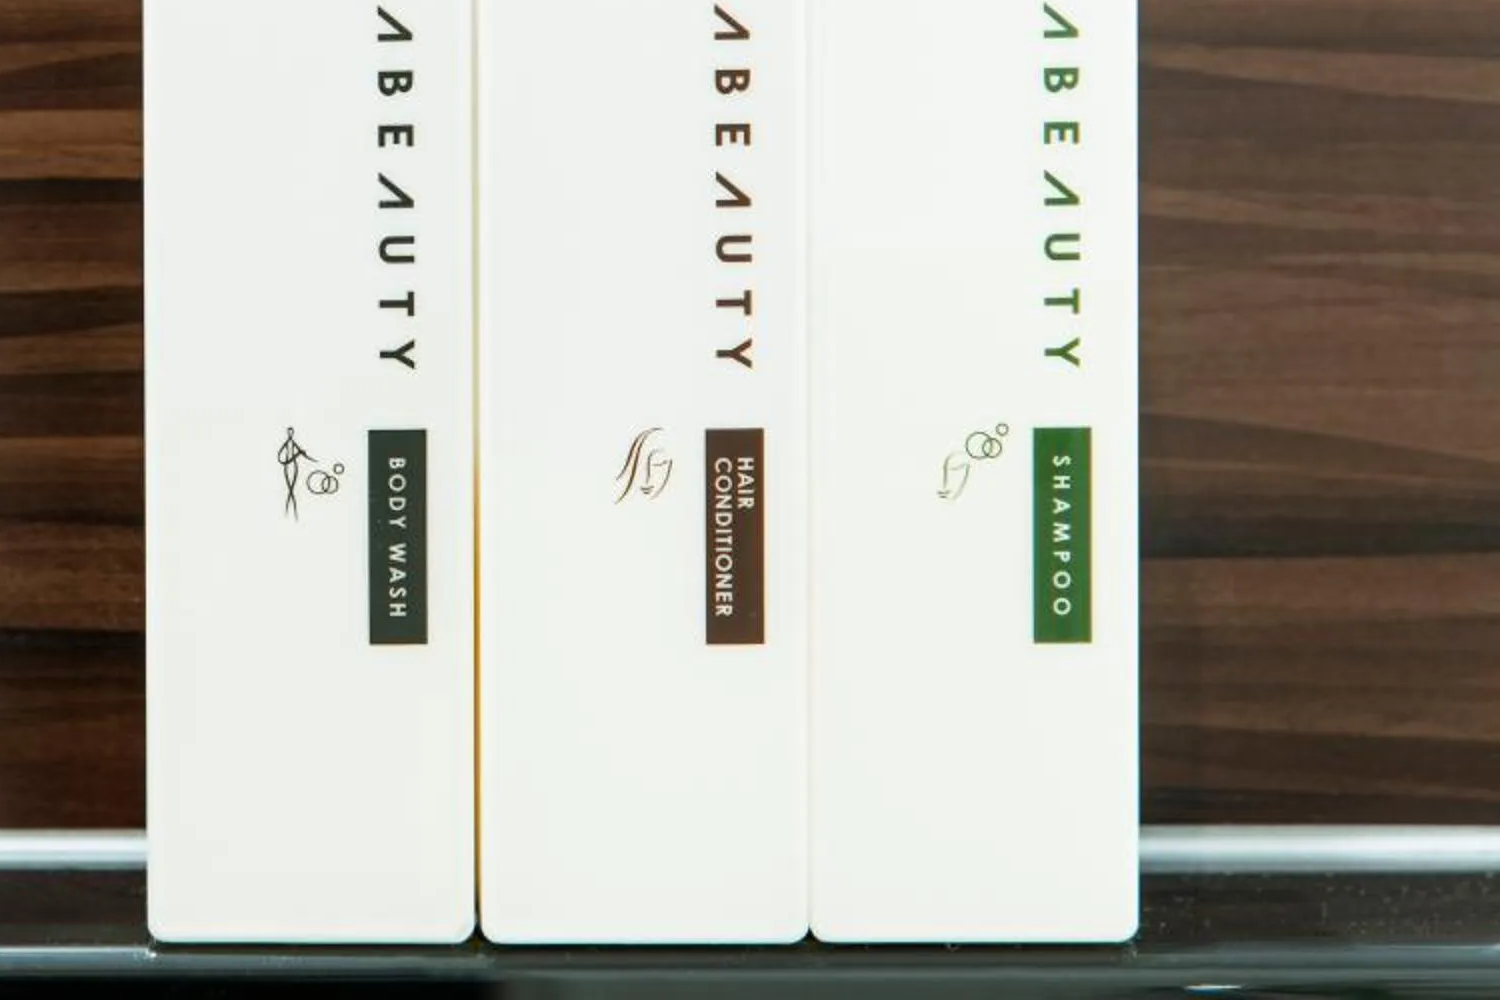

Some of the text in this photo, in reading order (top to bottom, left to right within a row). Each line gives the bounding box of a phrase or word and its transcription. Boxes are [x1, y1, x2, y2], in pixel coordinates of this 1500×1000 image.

[388, 456, 407, 617] BODY WASH
[714, 456, 733, 616] CONDITIONER
[737, 456, 755, 509] HAIR
[1052, 455, 1072, 615] SHAMPOO
